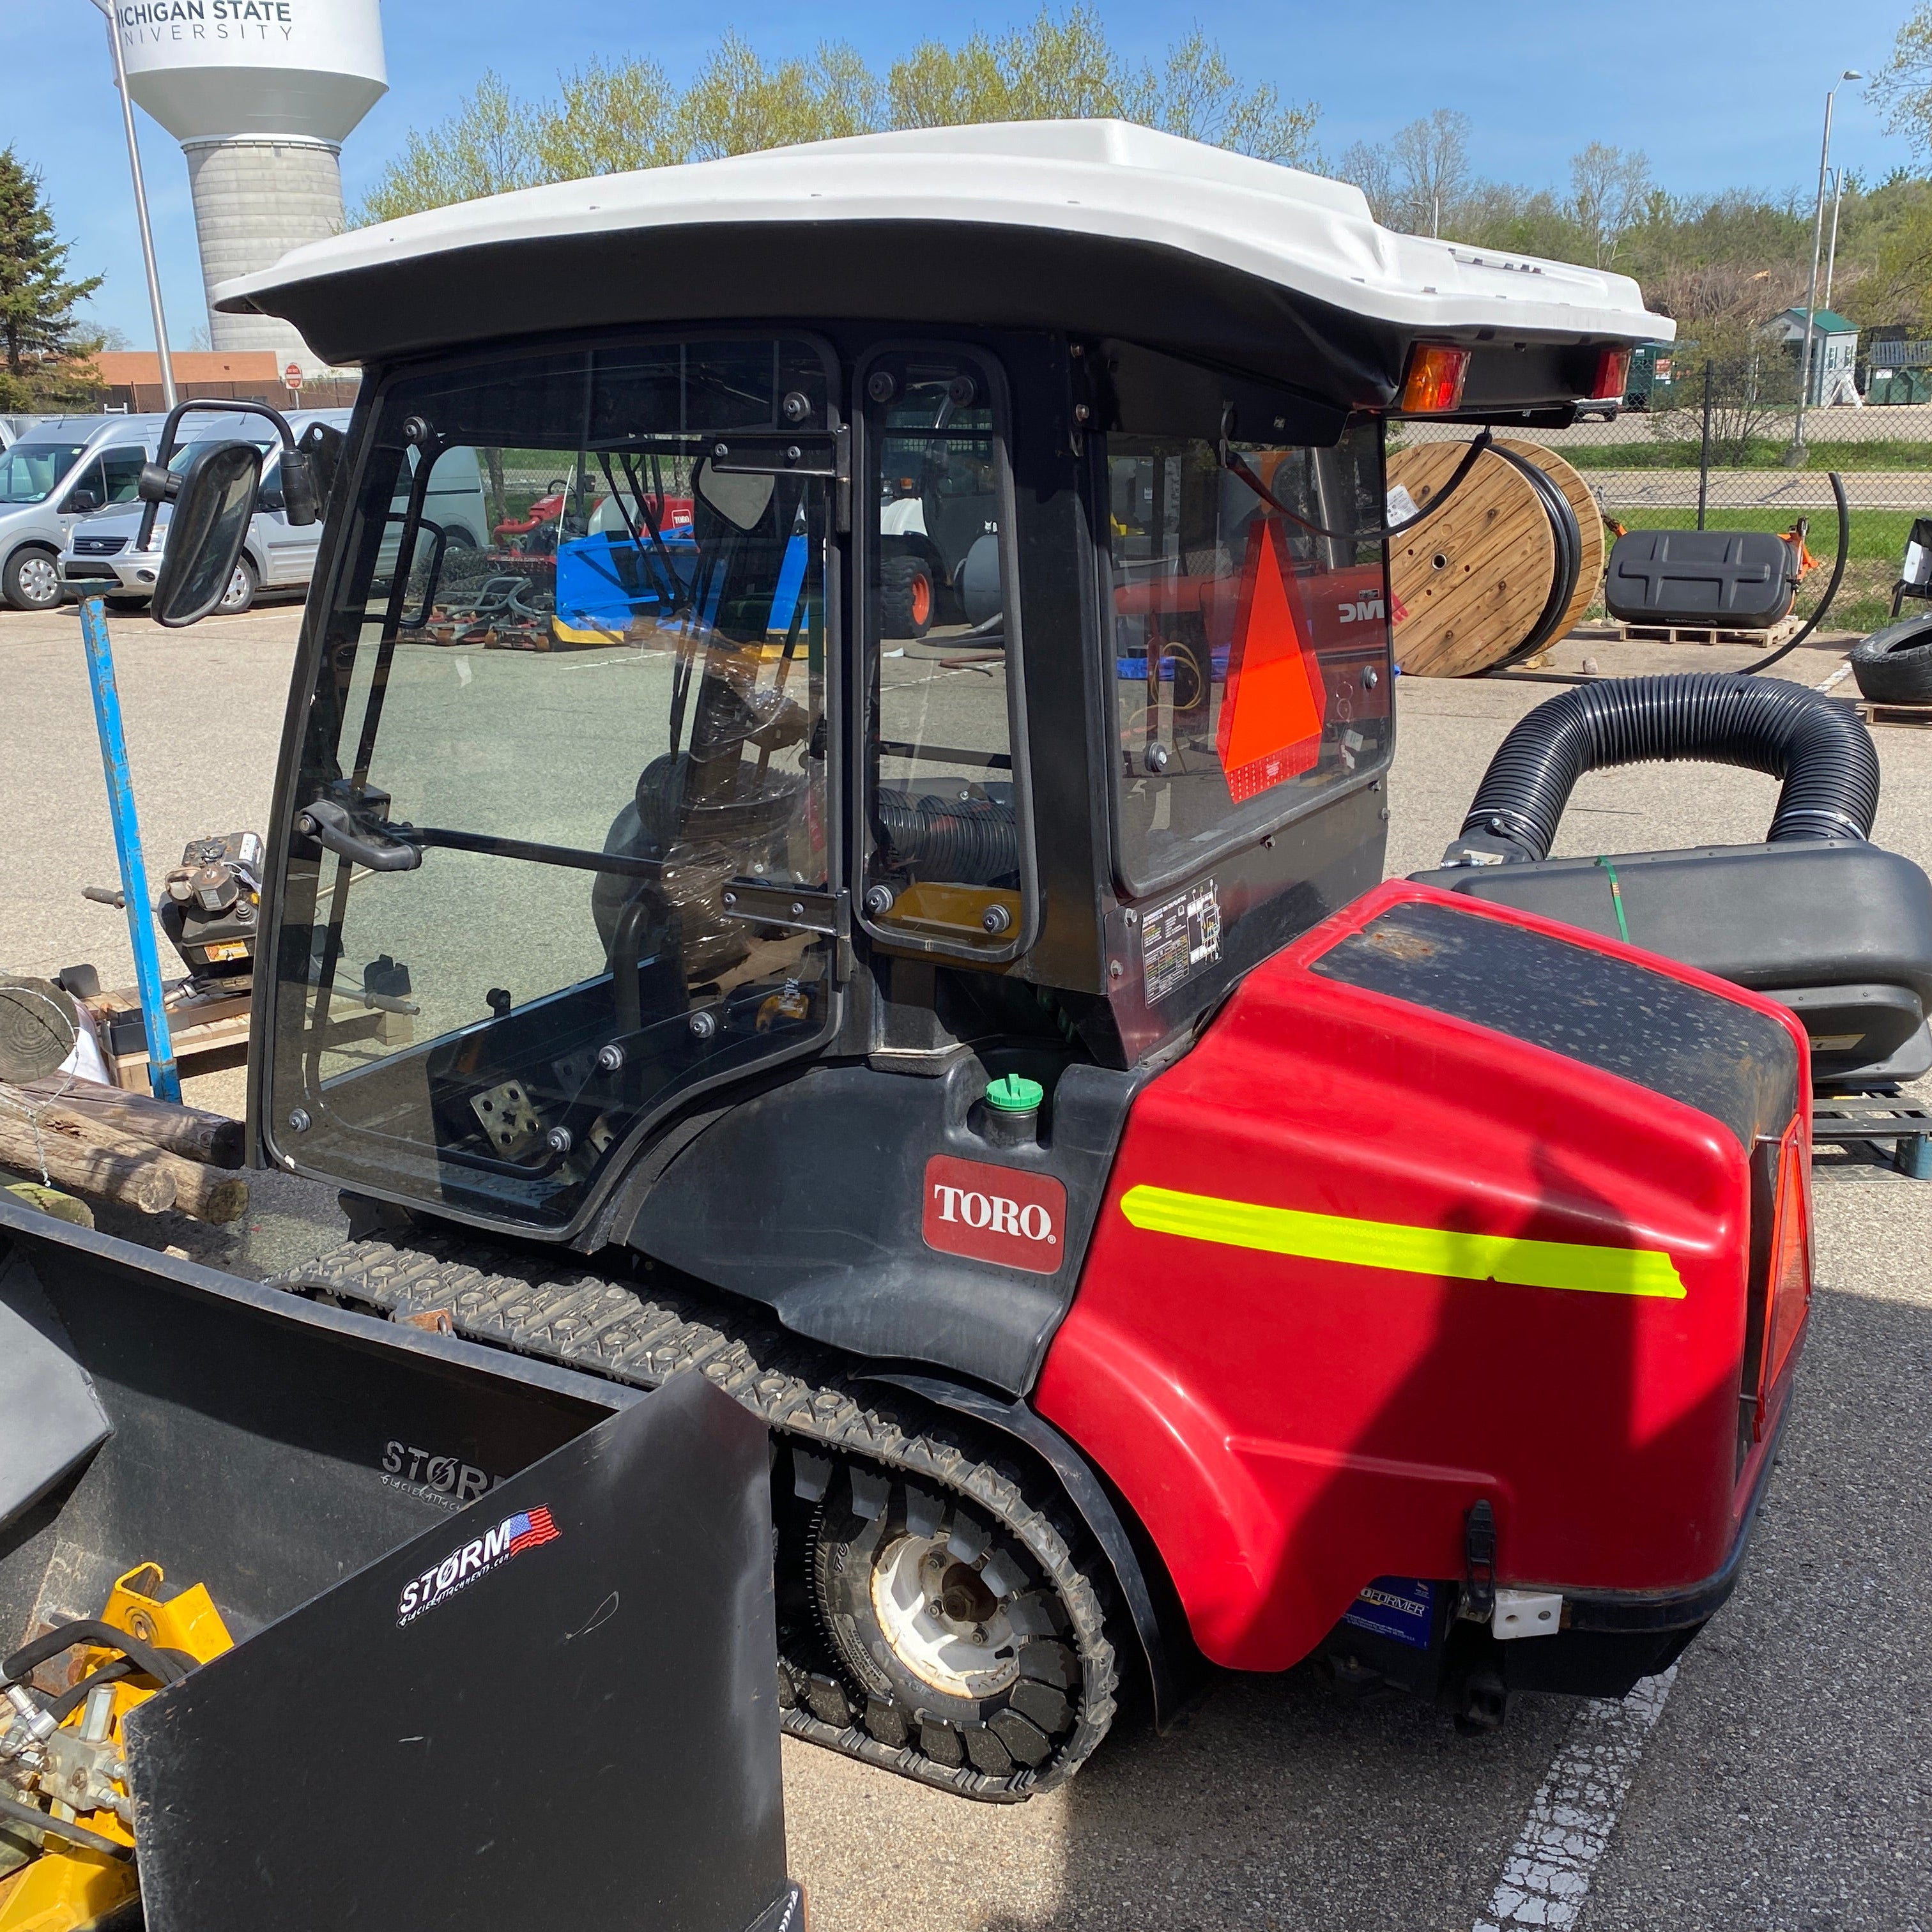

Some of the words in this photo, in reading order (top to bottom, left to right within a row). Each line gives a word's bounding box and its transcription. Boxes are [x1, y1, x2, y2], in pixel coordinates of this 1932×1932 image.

[212, 0, 292, 22] STATE
[125, 23, 292, 47] NIVERSITY
[934, 1184, 1052, 1241] TORO
